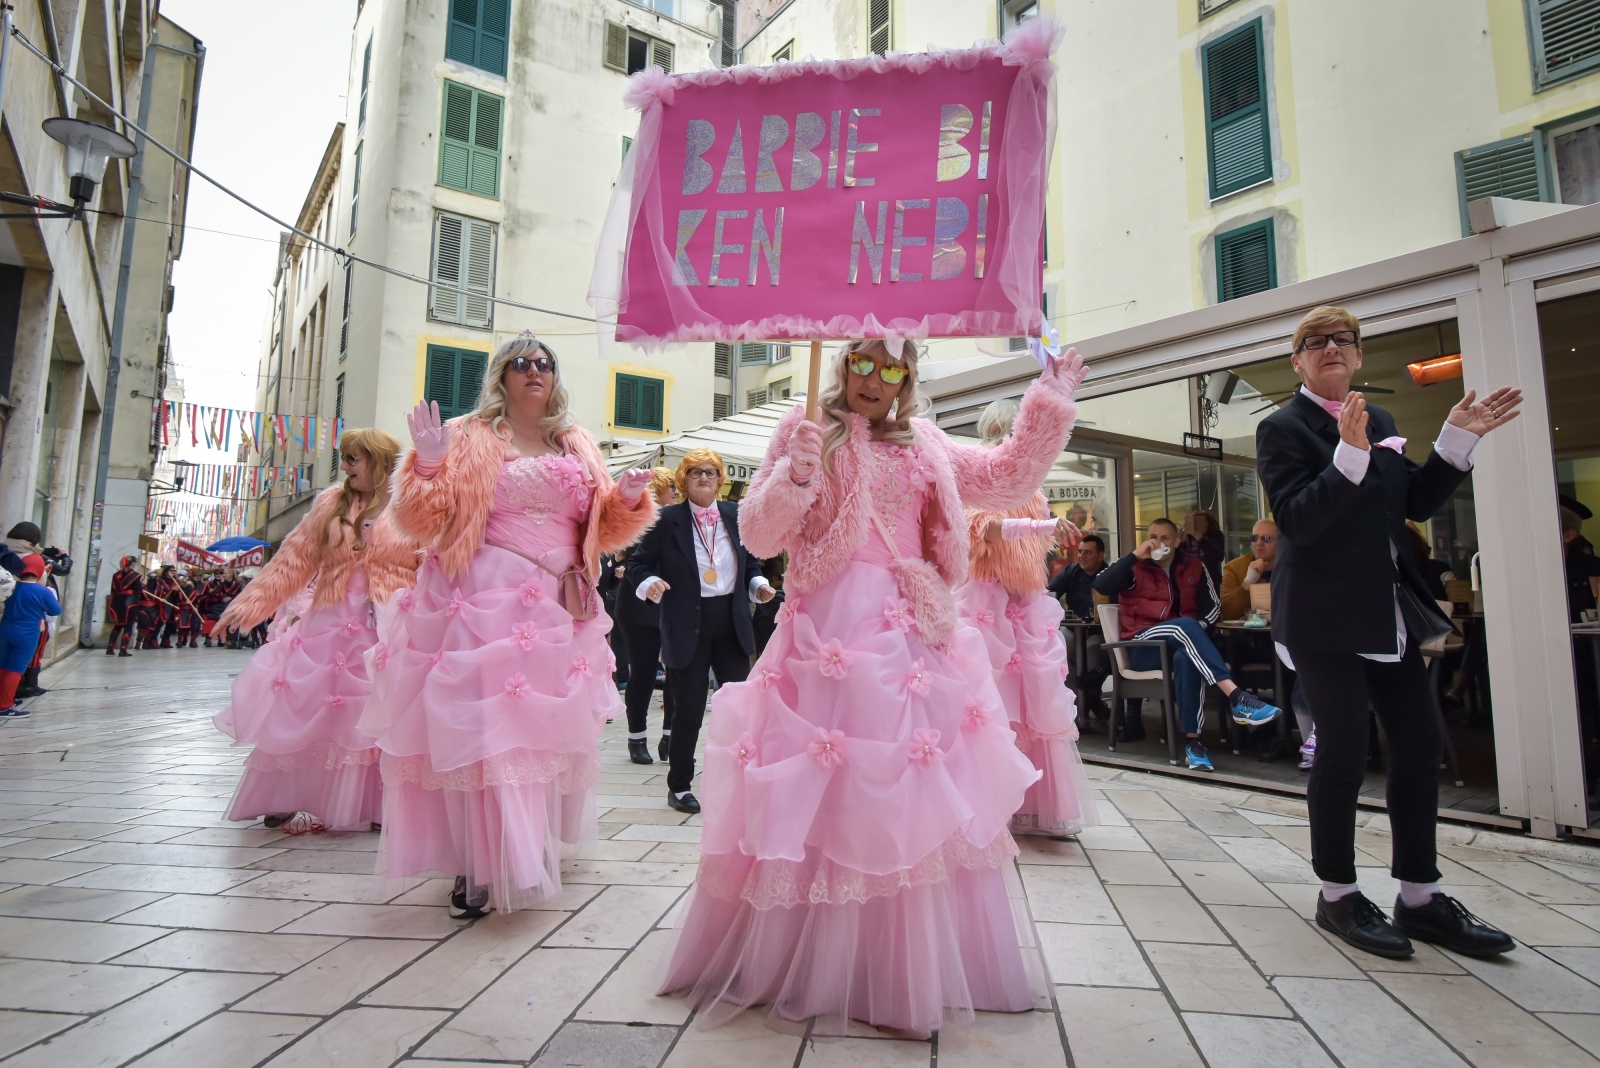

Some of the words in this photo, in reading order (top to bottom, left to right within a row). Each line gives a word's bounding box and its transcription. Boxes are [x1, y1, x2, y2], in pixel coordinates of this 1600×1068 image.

[681, 108, 882, 196] BARBIE
[936, 100, 993, 183] BI
[671, 206, 785, 287] KEN
[847, 193, 989, 286] NEBI
[235, 552, 262, 568] LITO
